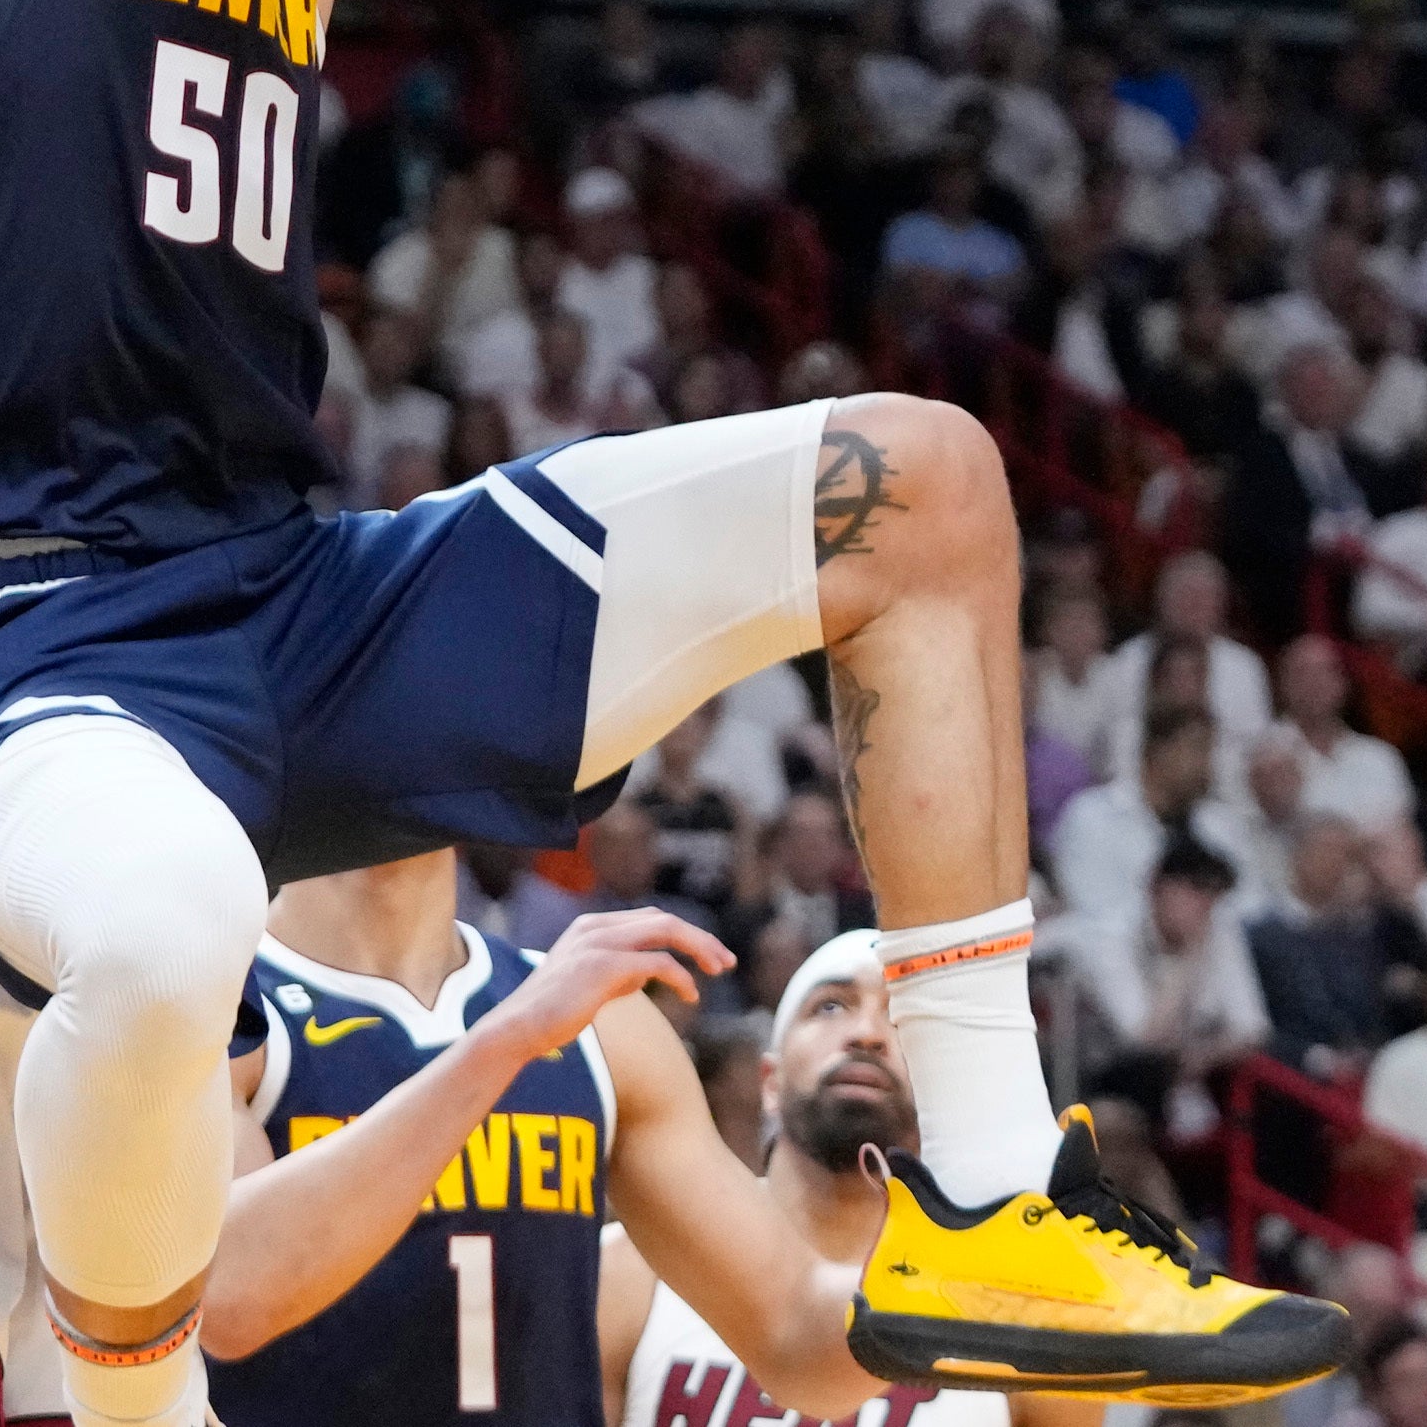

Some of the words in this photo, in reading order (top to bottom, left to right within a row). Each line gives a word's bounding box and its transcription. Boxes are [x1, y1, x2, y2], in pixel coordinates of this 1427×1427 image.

[143, 38, 301, 273] 50
[288, 1112, 596, 1216] VER
[448, 1233, 499, 1413] 1
